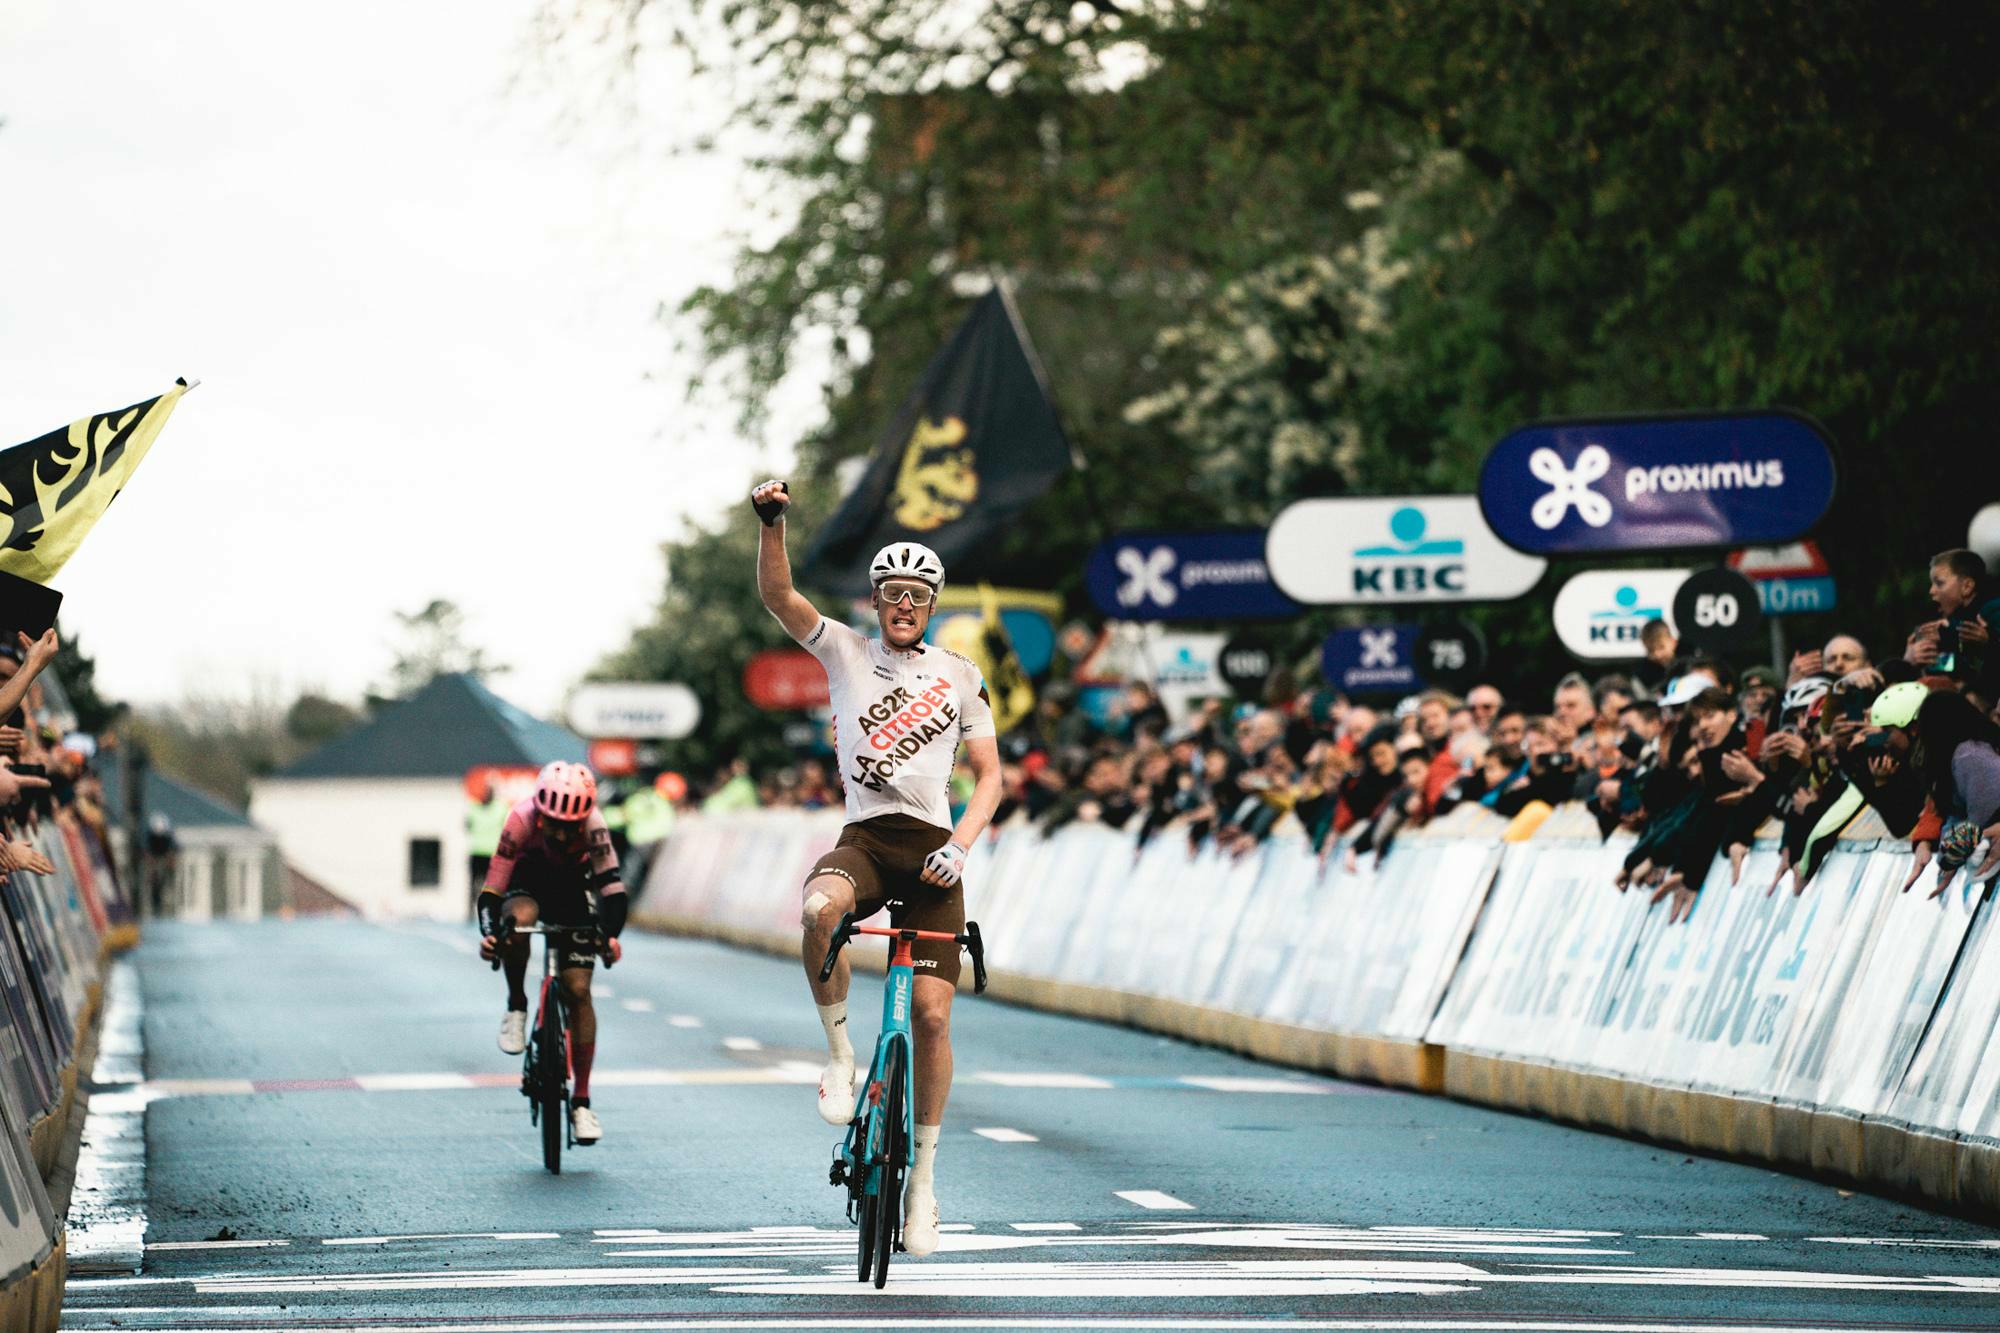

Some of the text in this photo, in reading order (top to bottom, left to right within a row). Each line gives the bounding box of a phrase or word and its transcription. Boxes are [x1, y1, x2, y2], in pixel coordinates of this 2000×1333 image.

[1625, 460, 1784, 502] proximus
[1181, 560, 1267, 589] proxim
[1353, 564, 1465, 592] KBC
[1695, 593, 1739, 627] 50
[1590, 625, 1641, 642] KB
[1430, 639, 1466, 670] 75
[858, 687, 915, 736] AG2R
[870, 677, 953, 751] CITROËN
[863, 703, 958, 793] MONDIALE
[851, 754, 876, 785] LA
[893, 974, 908, 1022] BMC
